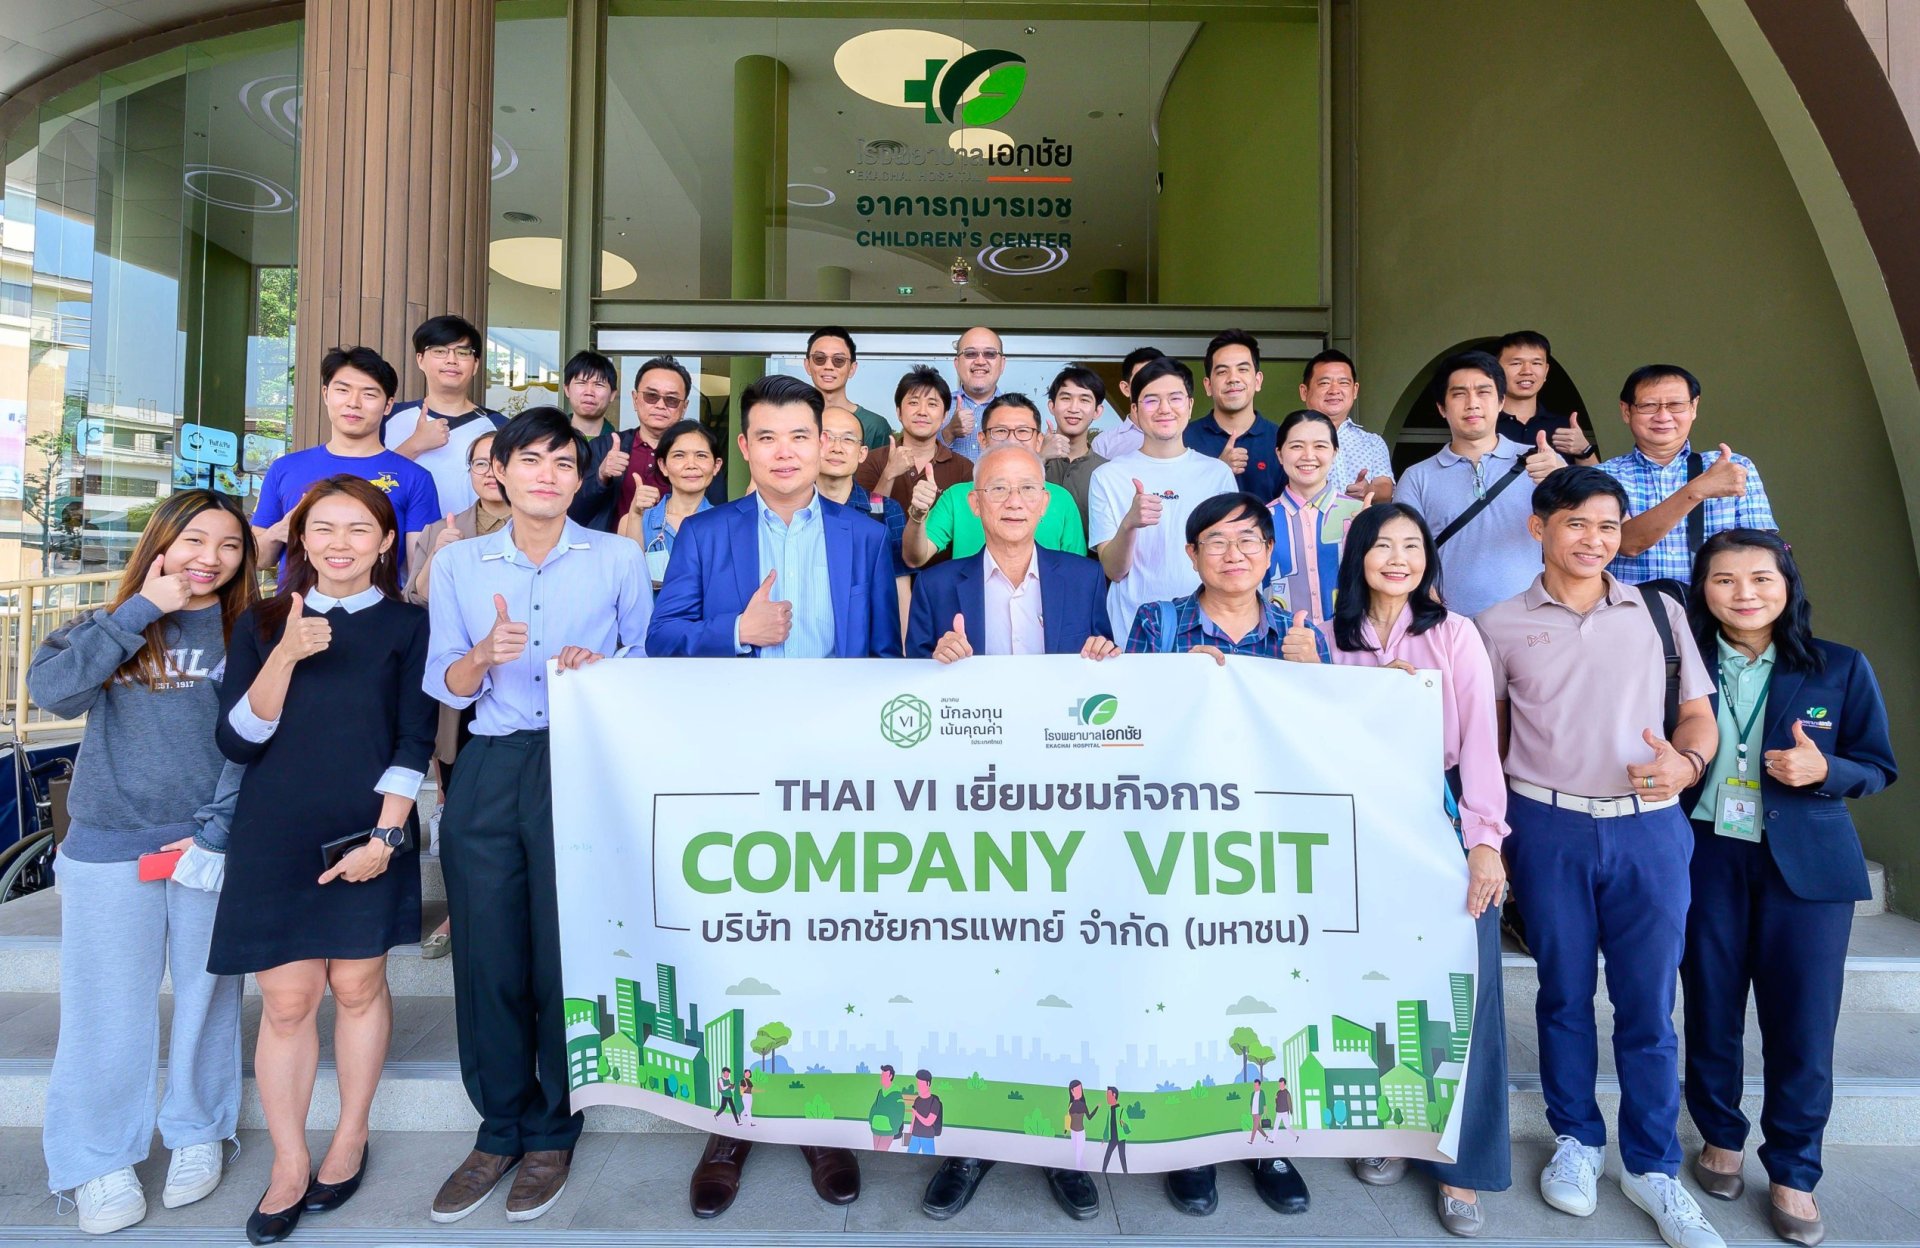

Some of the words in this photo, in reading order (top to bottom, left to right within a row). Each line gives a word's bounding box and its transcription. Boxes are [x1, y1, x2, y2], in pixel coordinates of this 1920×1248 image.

[856, 195, 1072, 227] อาคารกุมารเวช
[856, 231, 983, 247] CHILDREN'S
[989, 232, 1072, 248] CENTER
[175, 681, 195, 689] 1917
[899, 716, 913, 727] VI
[940, 705, 1003, 723] นักลงทุน
[940, 722, 1003, 739] เน้นคุณค่า
[775, 779, 875, 812] THAI
[893, 779, 937, 812] VI
[956, 764, 1240, 812] เยี่ยมชมกิจการ
[682, 830, 1086, 895] COMPANY
[1123, 830, 1330, 896] VISIT
[702, 910, 791, 943] บริษัท
[807, 909, 1066, 943] เอกชัยการแพทย์
[1080, 909, 1169, 947] จำกัด
[1185, 914, 1309, 950] (มหาชน)
